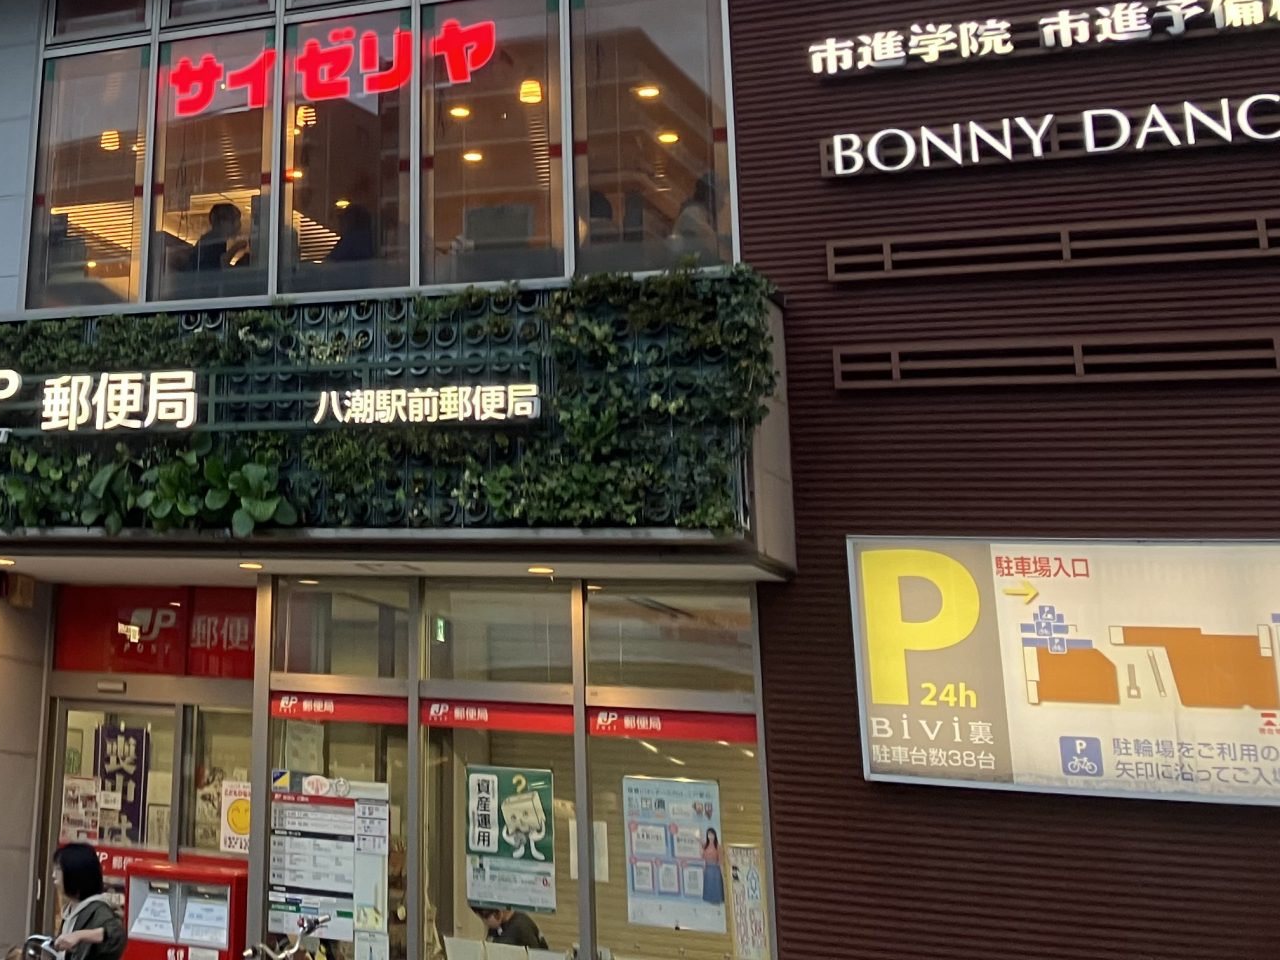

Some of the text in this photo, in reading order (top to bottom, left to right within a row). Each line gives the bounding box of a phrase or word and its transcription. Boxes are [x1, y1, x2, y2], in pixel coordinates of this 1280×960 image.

[808, 17, 1015, 75] 市進学院
[170, 19, 496, 117] サイゼリヤ
[832, 93, 1280, 176] BONNY DANC
[40, 369, 198, 432] 郵便局
[312, 383, 540, 426] 八潮駅前郵便局
[994, 555, 1090, 579] 駐車場入口
[190, 614, 255, 652] 郵便
[860, 548, 981, 706] P
[920, 682, 978, 709] 24h
[871, 713, 995, 745] BiVi裏
[871, 744, 997, 771] 駐車台数38台
[1112, 737, 1280, 763] 駐輪場をご利用の
